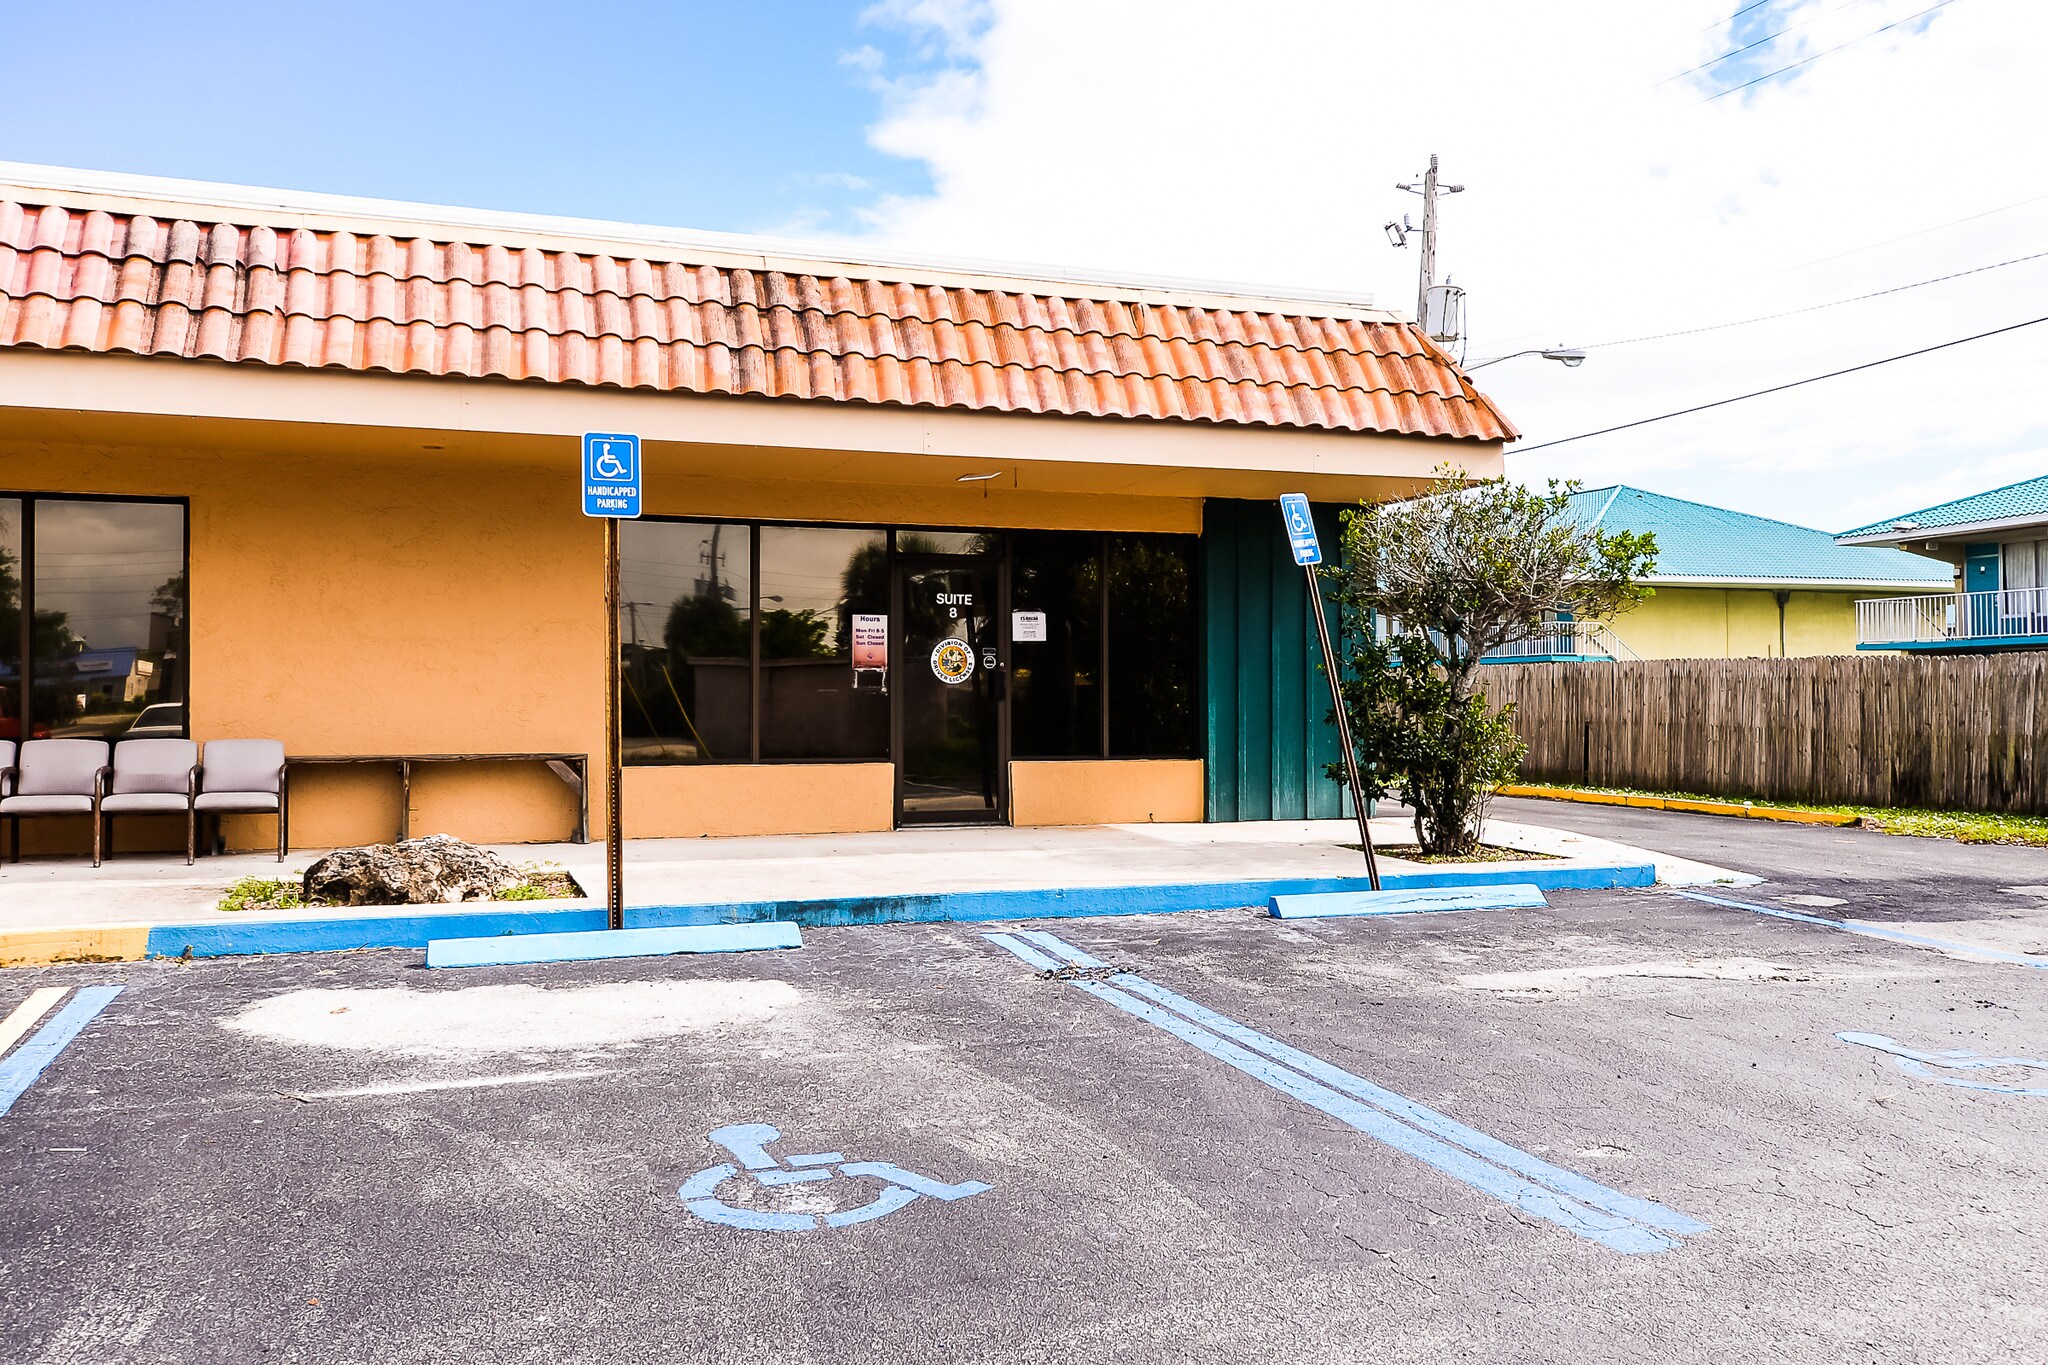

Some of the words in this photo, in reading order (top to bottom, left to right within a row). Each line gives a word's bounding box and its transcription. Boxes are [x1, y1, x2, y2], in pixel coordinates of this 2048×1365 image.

[588, 486, 636, 497] HANDICAPPED
[596, 498, 627, 509] PARKING
[936, 593, 972, 605] SUITE
[949, 607, 958, 618] 8
[936, 640, 963, 654] DIVISION
[933, 660, 948, 680] DRIVER
[950, 662, 972, 682] LICENSES
